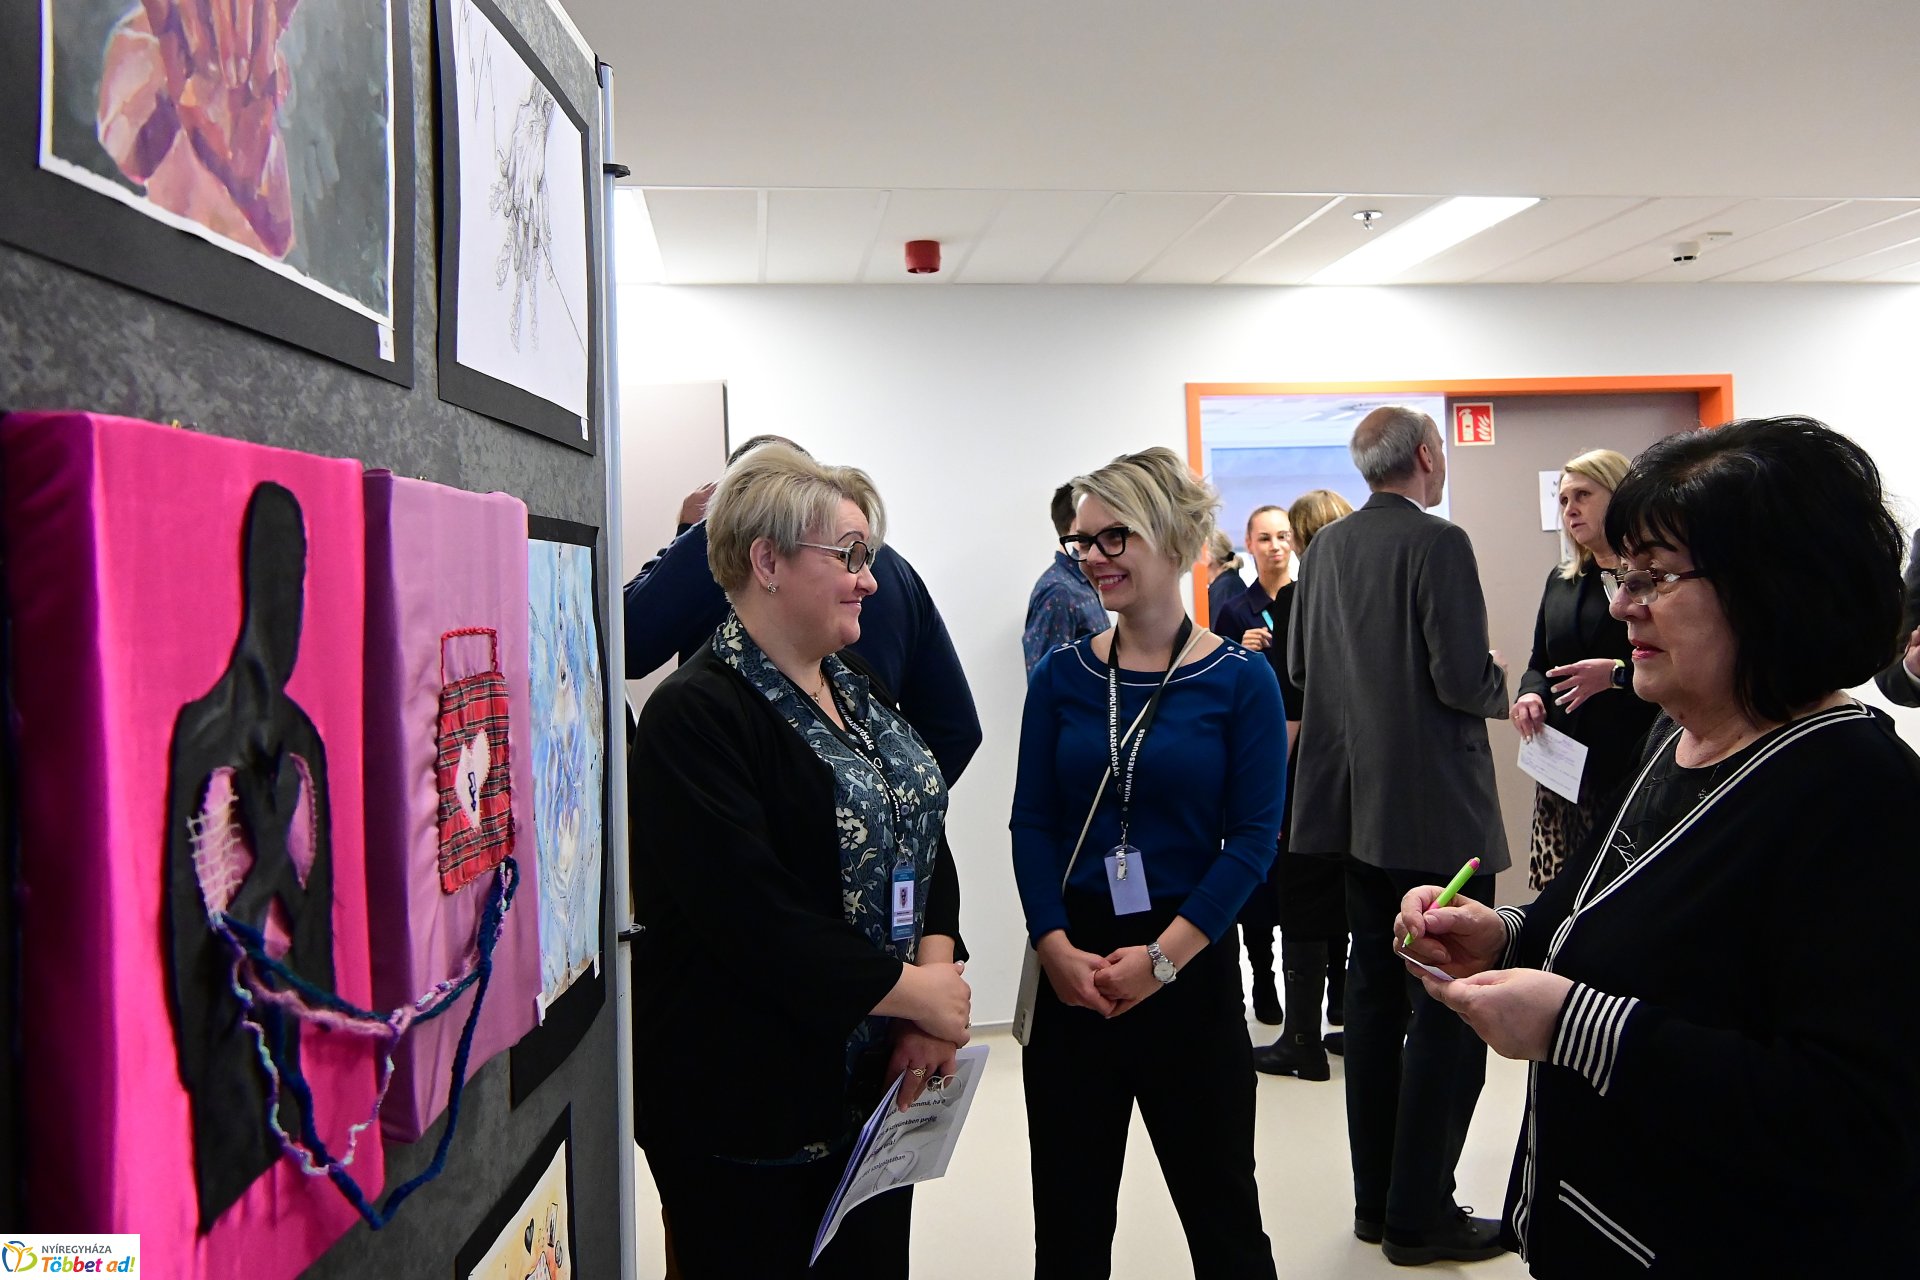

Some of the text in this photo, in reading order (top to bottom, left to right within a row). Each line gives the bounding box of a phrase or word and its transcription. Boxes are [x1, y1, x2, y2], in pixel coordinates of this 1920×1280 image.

[1109, 727, 1120, 777] IGAZGATÓSÁG
[1124, 728, 1146, 802] HUMAN RESOURCES
